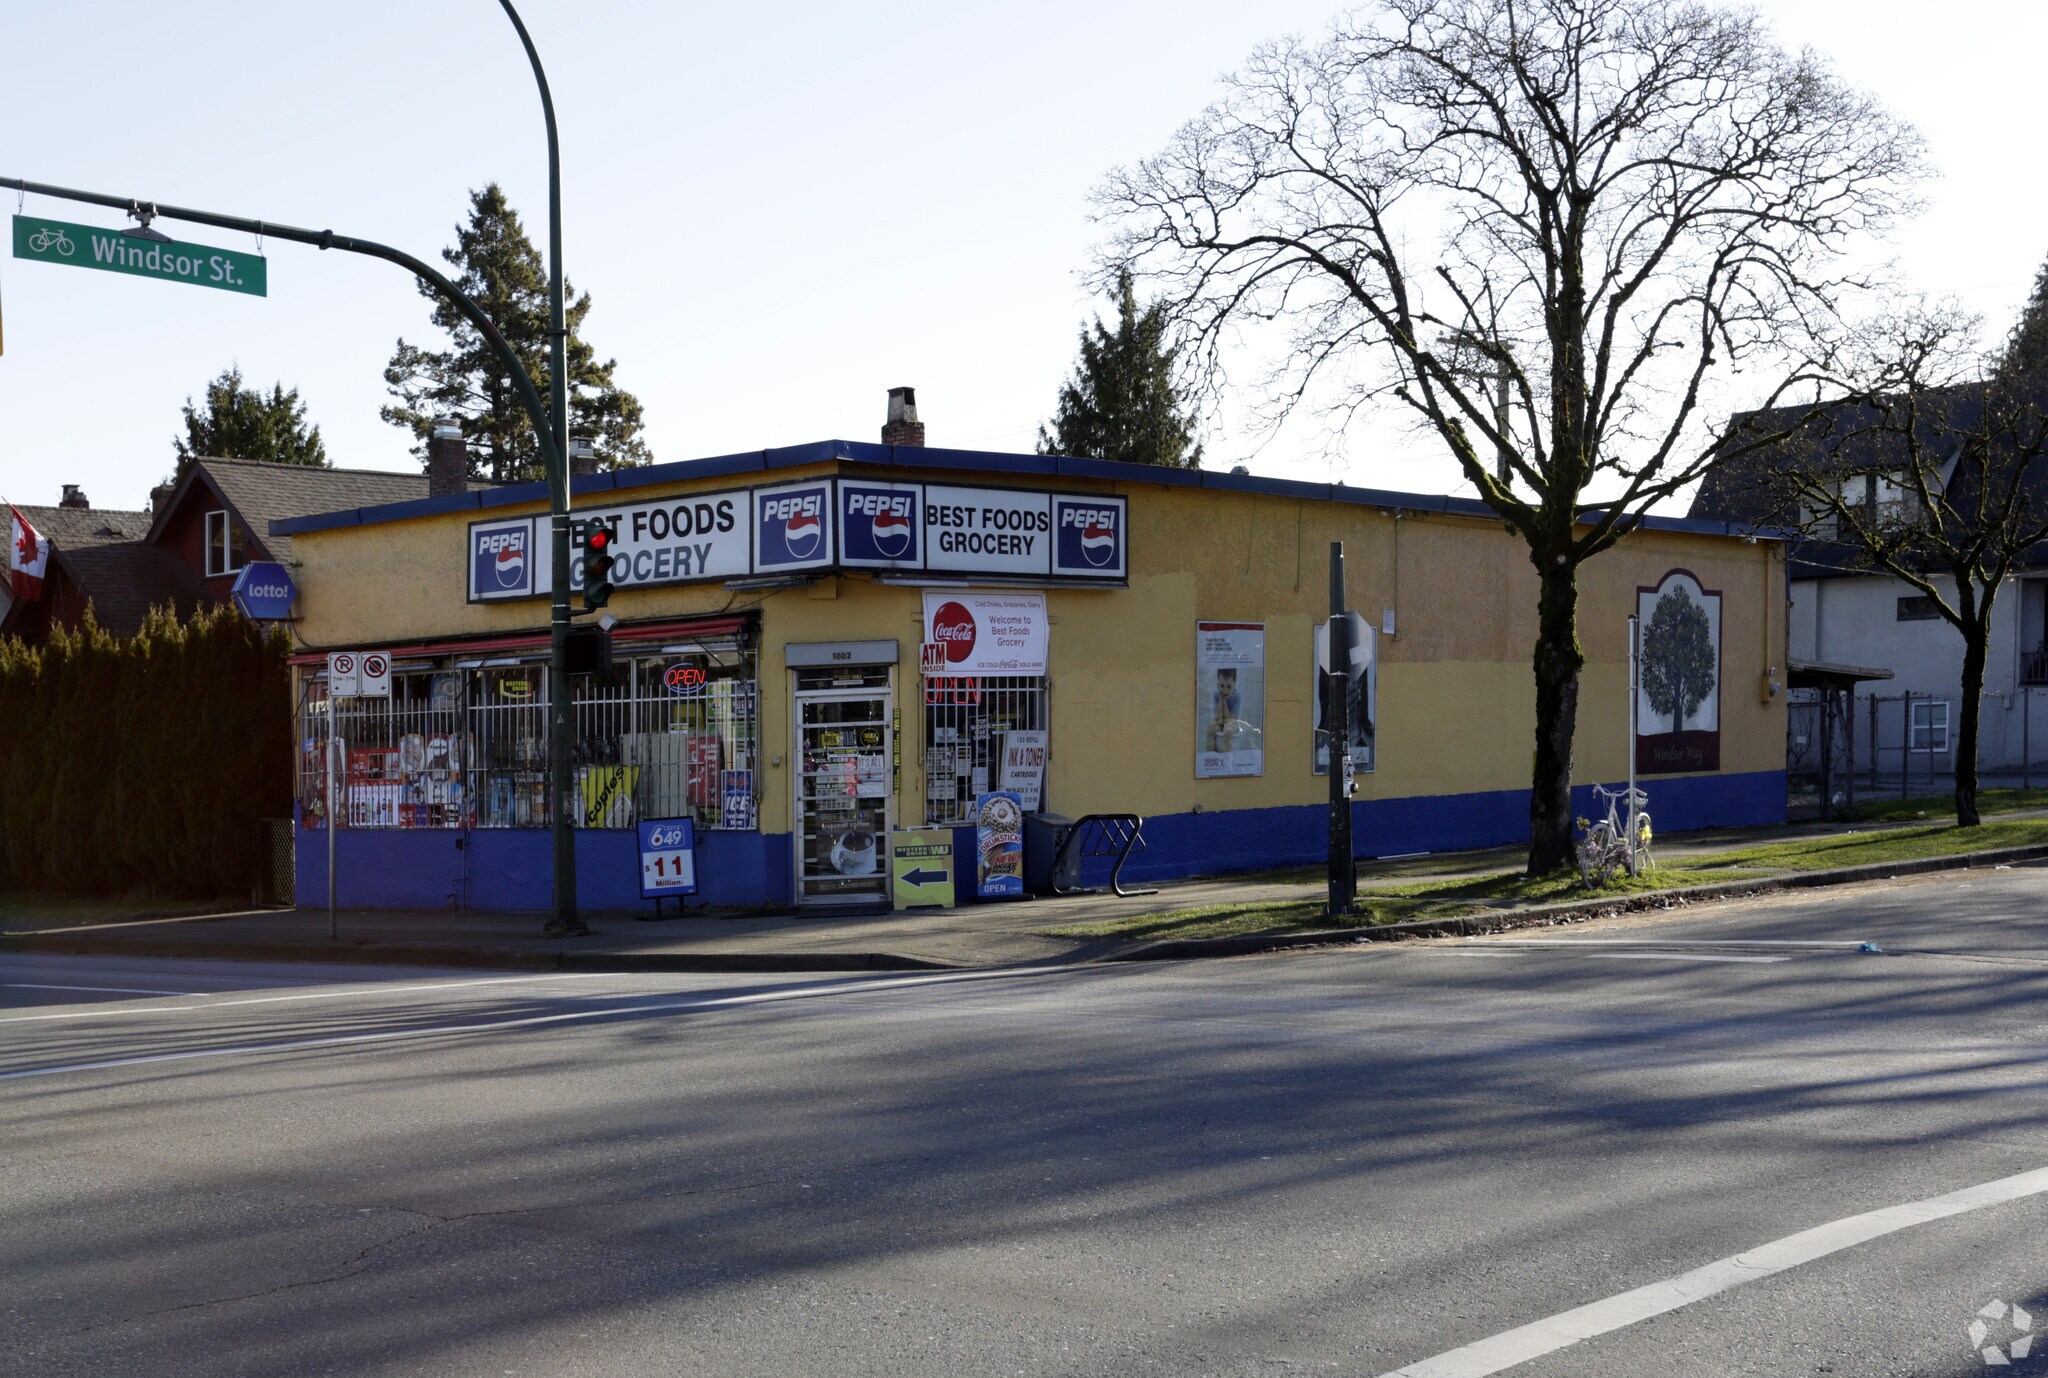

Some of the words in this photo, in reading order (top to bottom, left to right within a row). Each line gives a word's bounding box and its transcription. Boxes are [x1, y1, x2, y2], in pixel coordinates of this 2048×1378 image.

[91, 235, 203, 277] Windsor
[210, 255, 244, 286] St.
[764, 494, 822, 522] PEPSI
[848, 494, 911, 517] PEPSI
[631, 500, 735, 542] FOODS
[927, 505, 976, 528] BEST
[982, 508, 1049, 532] FOODS
[1061, 508, 1116, 530] PEPSI
[479, 532, 526, 555] PEPSI
[939, 531, 1035, 556] GROCERY
[570, 542, 713, 588] GOCERY
[248, 583, 289, 598] lotto!
[935, 622, 975, 640] Coca-Cola
[989, 616, 1022, 624] Welcome
[991, 627, 1008, 635] Best
[1009, 627, 1030, 635] Foods
[922, 643, 946, 665] ATM
[997, 638, 1025, 648] Grocery
[832, 652, 852, 660] 1002
[666, 670, 706, 684] OPEN
[926, 676, 982, 704] OPEN
[1653, 743, 1685, 761] Windsor
[1686, 745, 1704, 765] Way
[980, 833, 1020, 853] DRUMSTICK
[984, 884, 1006, 893] OPEN
